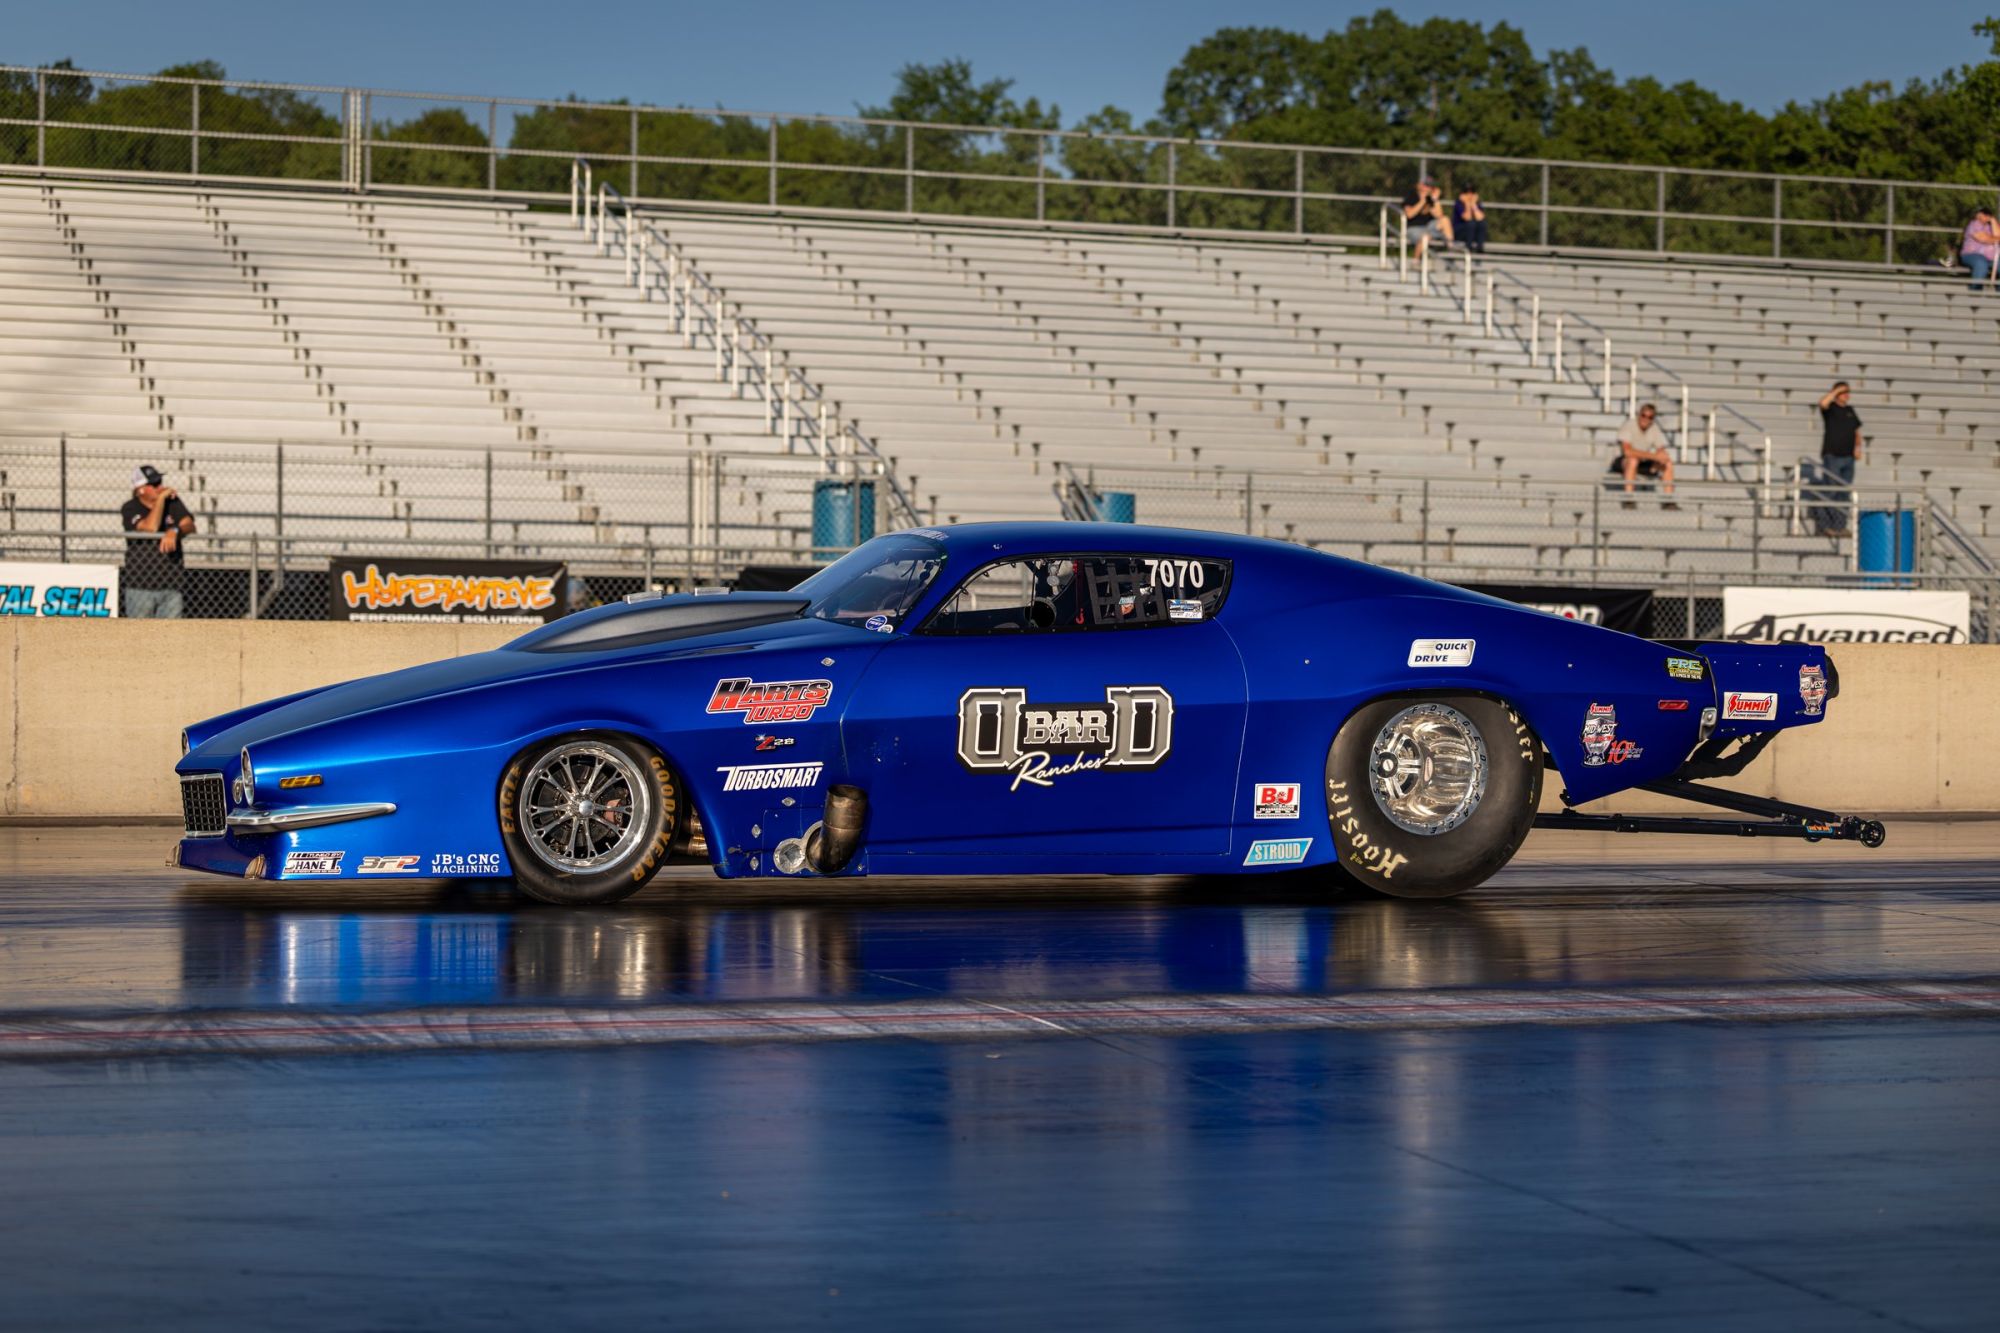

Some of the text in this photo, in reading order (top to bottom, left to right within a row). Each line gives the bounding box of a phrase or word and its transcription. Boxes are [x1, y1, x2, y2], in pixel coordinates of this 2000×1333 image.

[1144, 559, 1204, 588] 7070
[41, 586, 111, 618] SEAL
[1727, 614, 1958, 644] Advanced
[1435, 643, 1468, 651] QUICK
[708, 680, 831, 711] HARTS
[1728, 694, 1773, 717] SUMMIT
[746, 704, 814, 722] TURBO
[1023, 711, 1110, 744] BAR
[1106, 686, 1174, 765] D
[716, 761, 824, 791] TURBOSMART
[1008, 751, 1109, 792] Ranches
[1261, 787, 1295, 805] B&J
[432, 854, 500, 865] JB's CNC
[1254, 842, 1301, 861] STROUD
[432, 865, 500, 874] MACHINING
